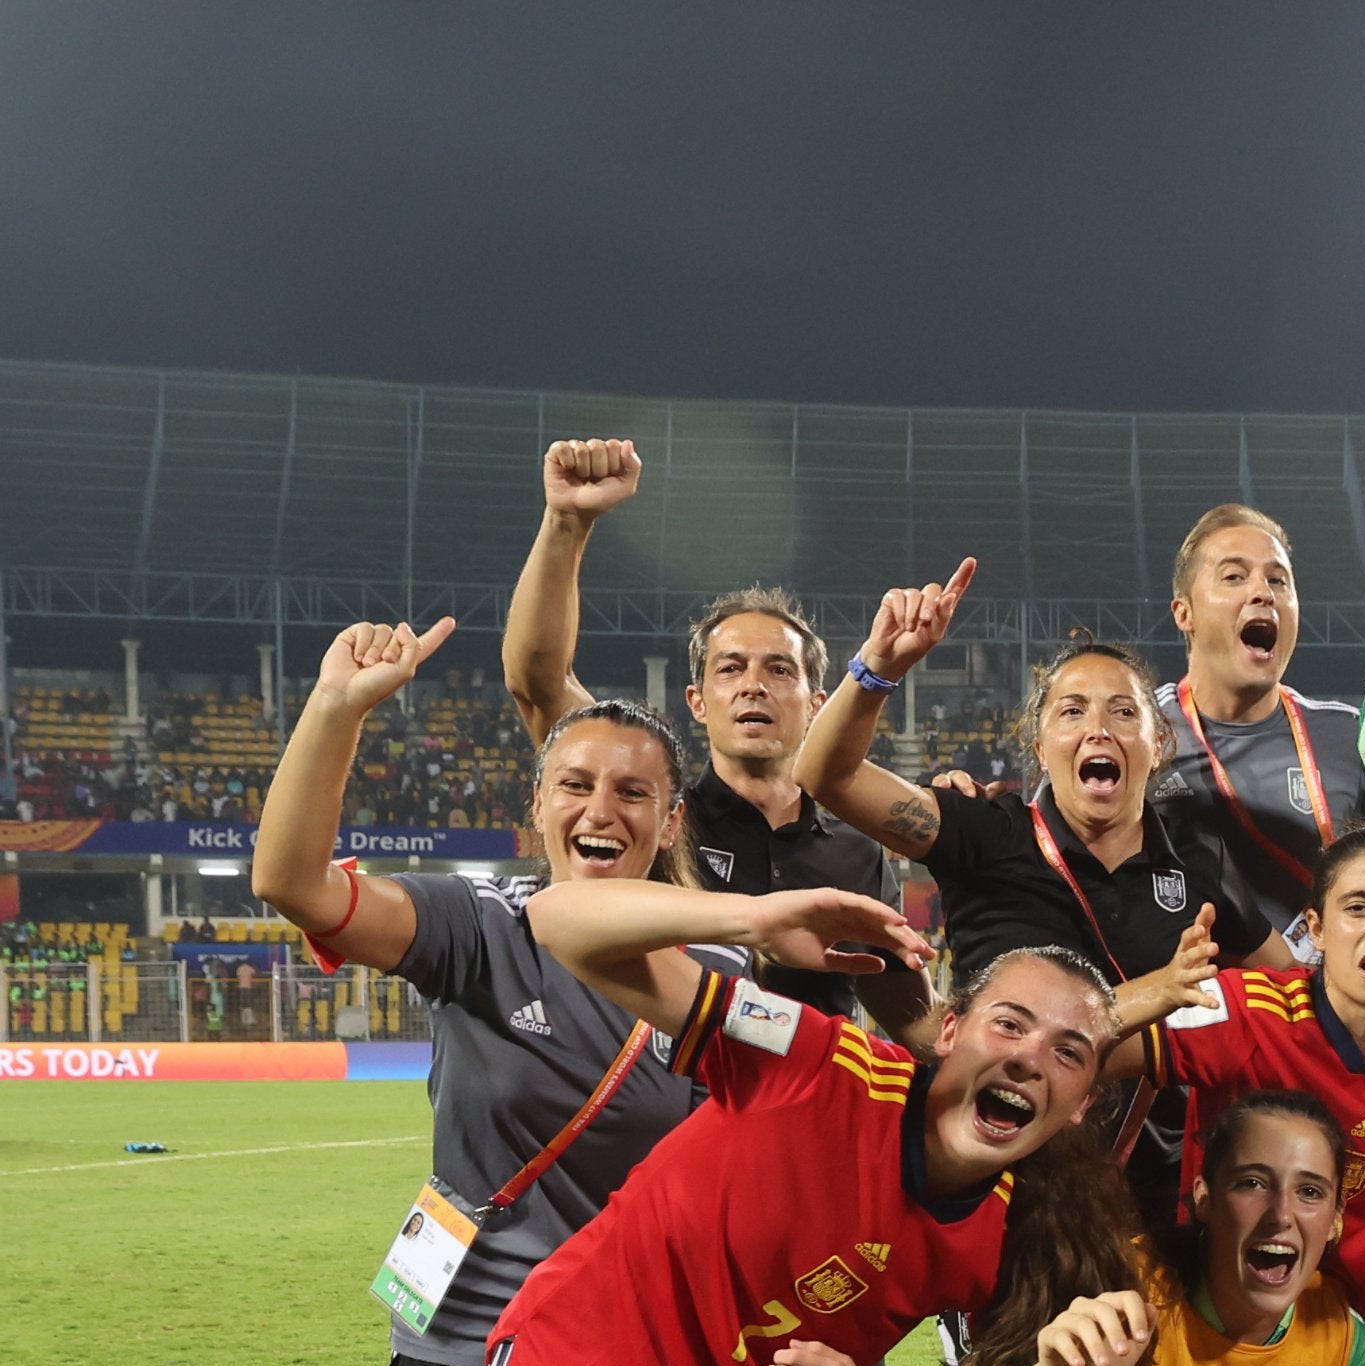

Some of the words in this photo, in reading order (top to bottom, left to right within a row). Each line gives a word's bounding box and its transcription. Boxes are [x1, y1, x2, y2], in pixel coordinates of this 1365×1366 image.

[188, 828, 242, 848] Kick
[510, 1015, 552, 1036] adidas
[42, 1049, 160, 1078] TODAY
[572, 1117, 585, 1132] FIFA
[615, 1049, 635, 1075] WORLD
[854, 1242, 887, 1272] adidas
